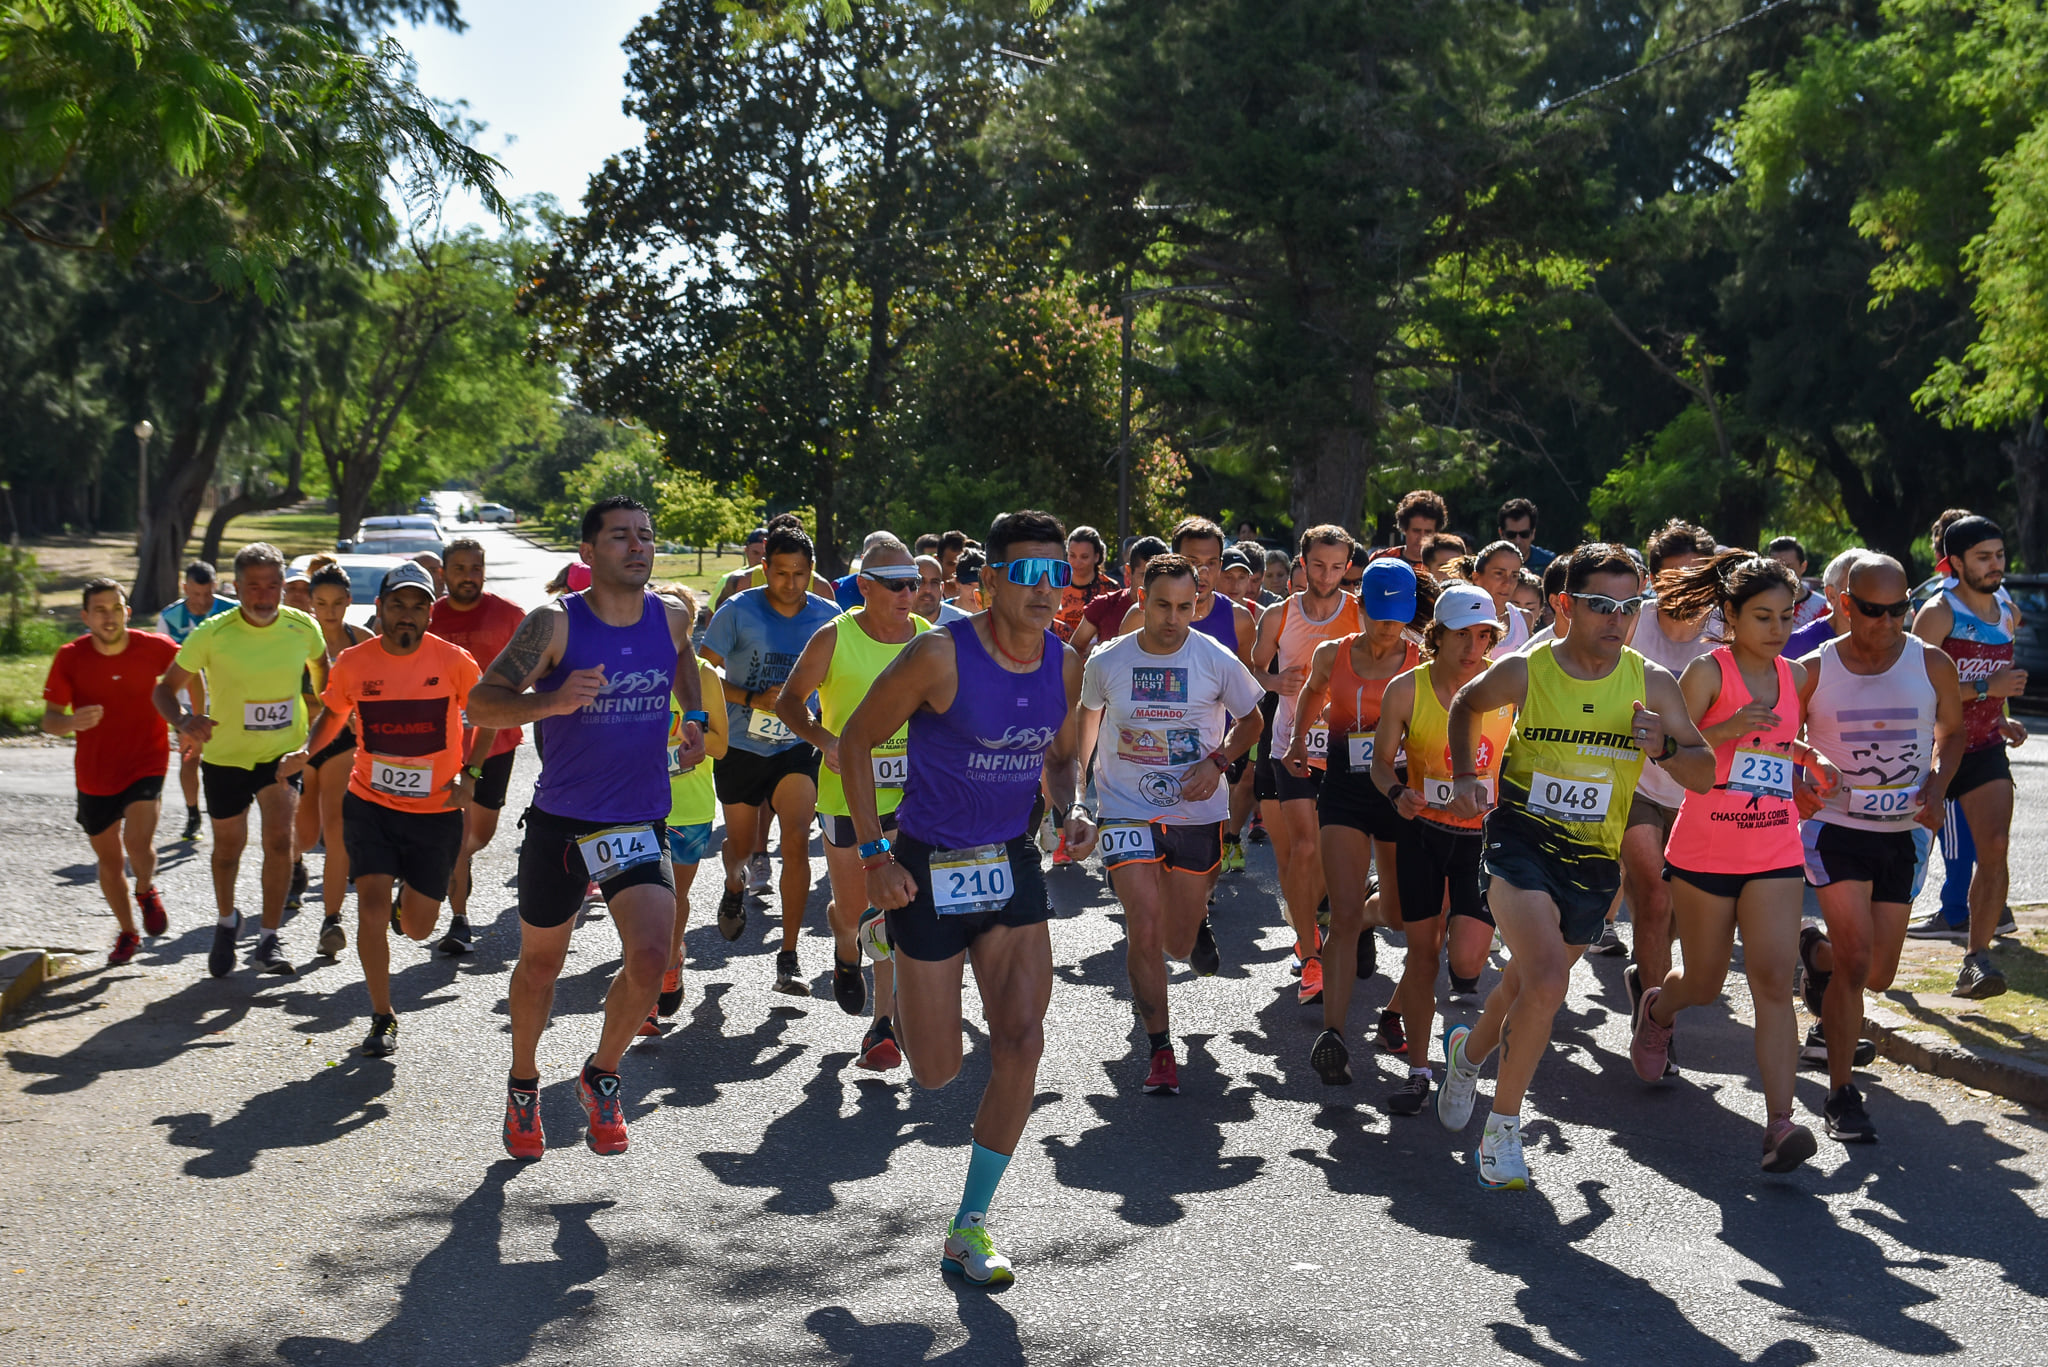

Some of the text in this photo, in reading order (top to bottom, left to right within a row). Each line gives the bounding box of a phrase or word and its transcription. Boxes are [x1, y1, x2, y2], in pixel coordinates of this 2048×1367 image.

[255, 705, 288, 722] 042
[1136, 709, 1183, 718] MACHADO
[382, 721, 437, 735] CAMEL
[1523, 727, 1641, 751] ENDURANC
[382, 768, 421, 788] 022
[1742, 757, 1783, 784] 233
[1546, 782, 1599, 810] 048
[1864, 792, 1909, 812] 202
[1711, 812, 1766, 822] CHASCOMUS
[596, 837, 645, 863] 014
[1102, 830, 1142, 852] 070
[949, 868, 1005, 899] 210
